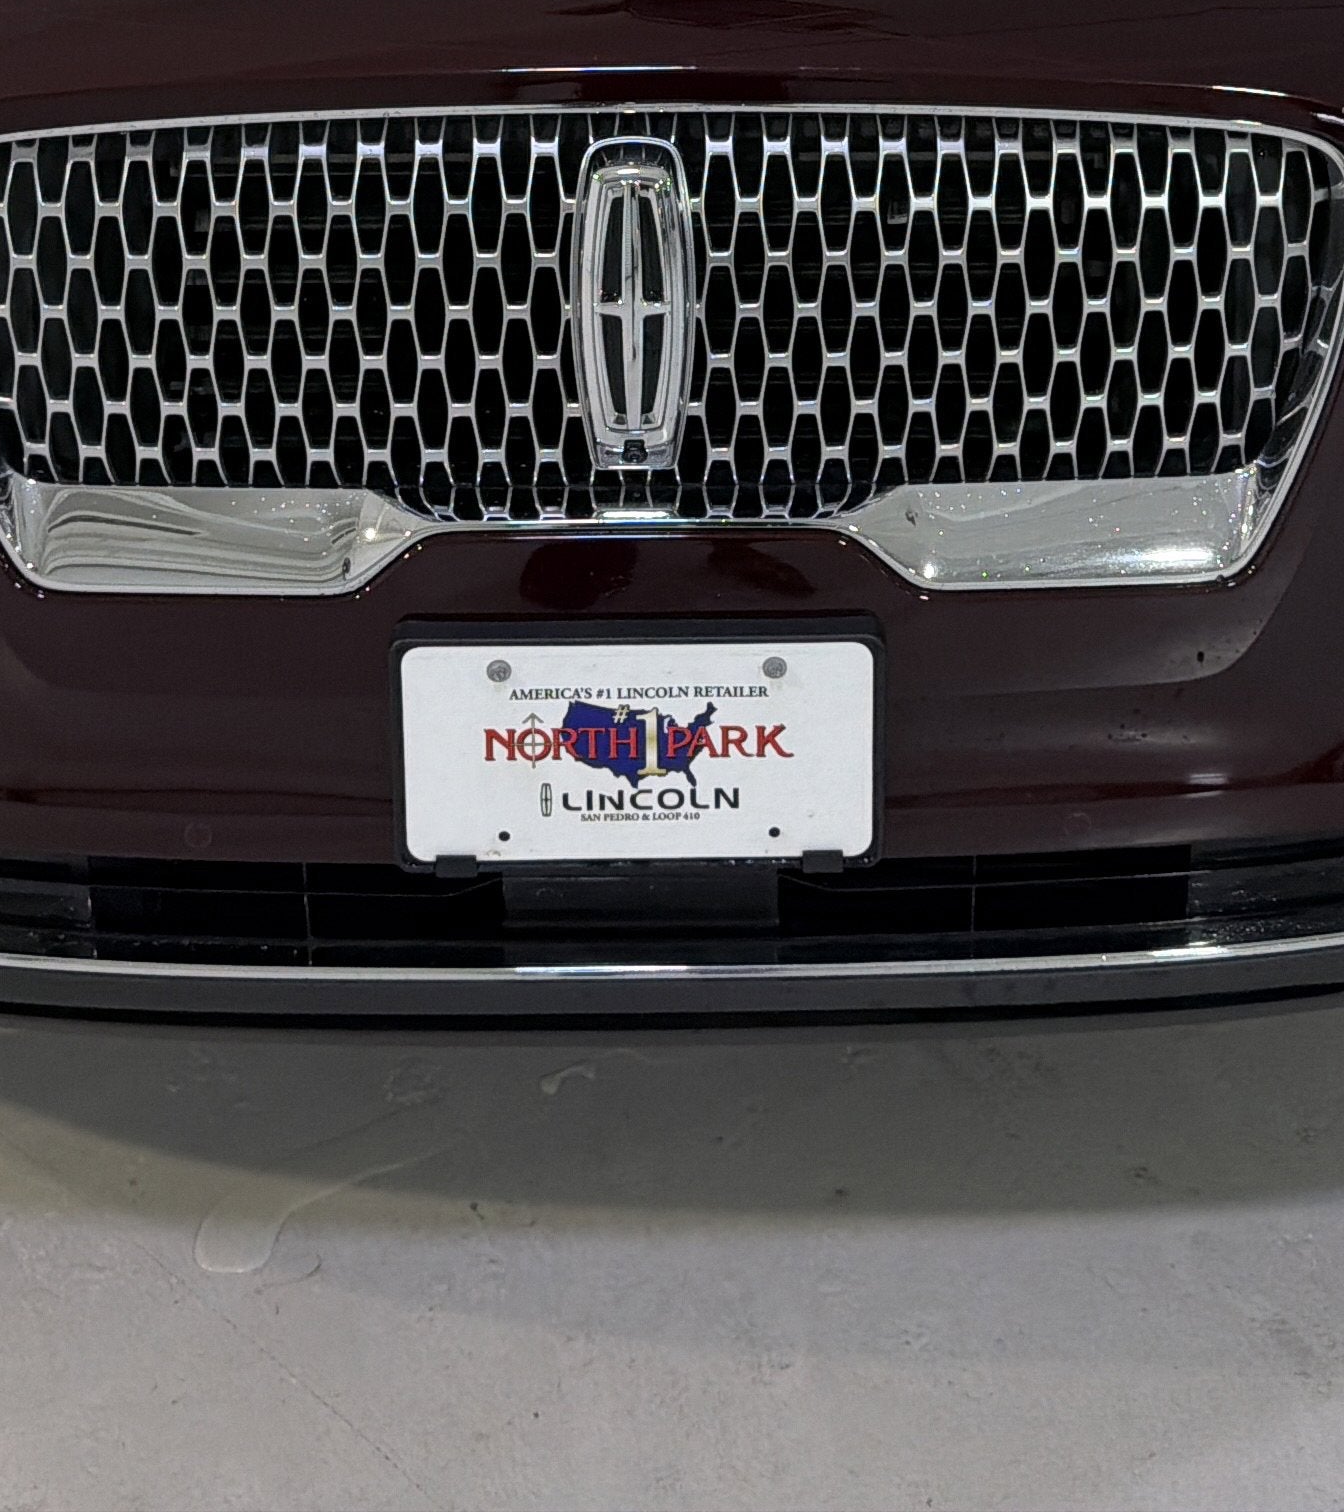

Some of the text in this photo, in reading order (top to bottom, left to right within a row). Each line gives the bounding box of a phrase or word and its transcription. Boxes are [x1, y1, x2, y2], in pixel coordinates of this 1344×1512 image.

[509, 685, 770, 701] AMERICA'S #1 LINCOLN RETAILER
[483, 723, 795, 762] NORTH PARK
[561, 787, 740, 812] LINCOLN
[580, 811, 701, 822] SAN PEDRO & LOOP 410
